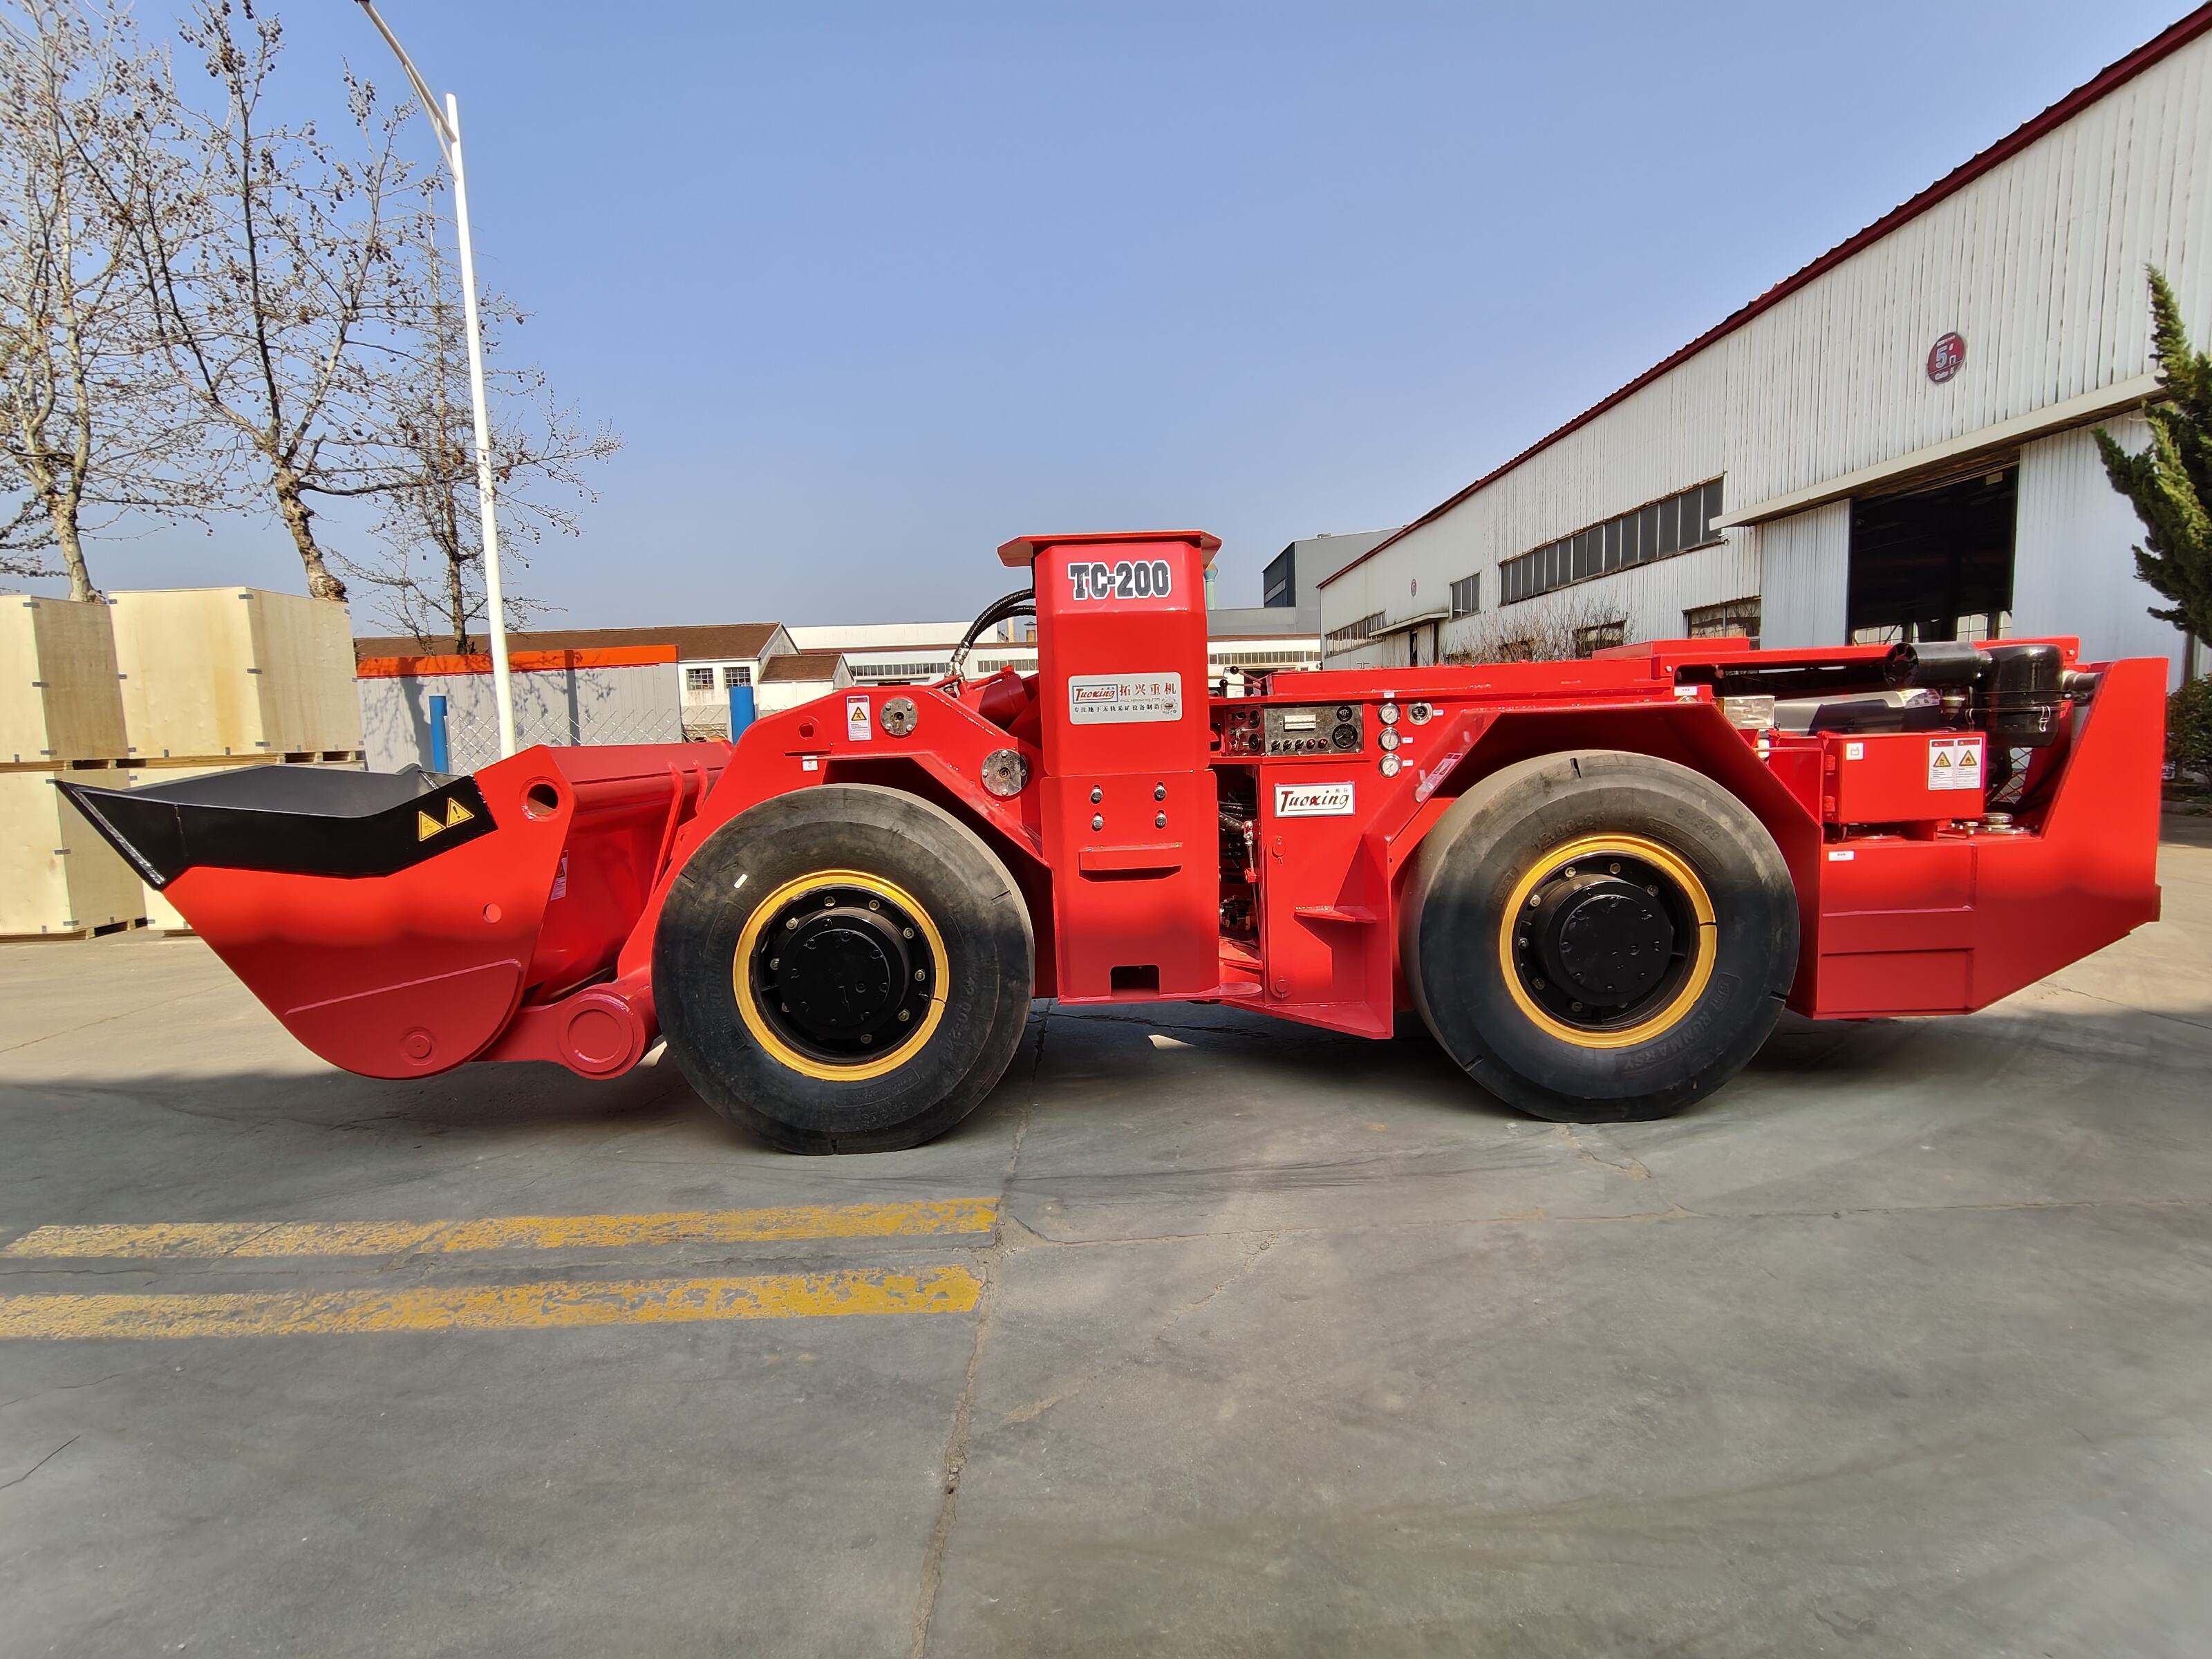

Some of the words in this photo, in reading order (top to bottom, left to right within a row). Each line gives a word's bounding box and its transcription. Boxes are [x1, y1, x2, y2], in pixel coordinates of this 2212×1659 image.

[1076, 687, 1115, 702] Tuoxing
[1119, 683, 1177, 697] 拓兴重机
[1280, 789, 1350, 813] Tuoxing
